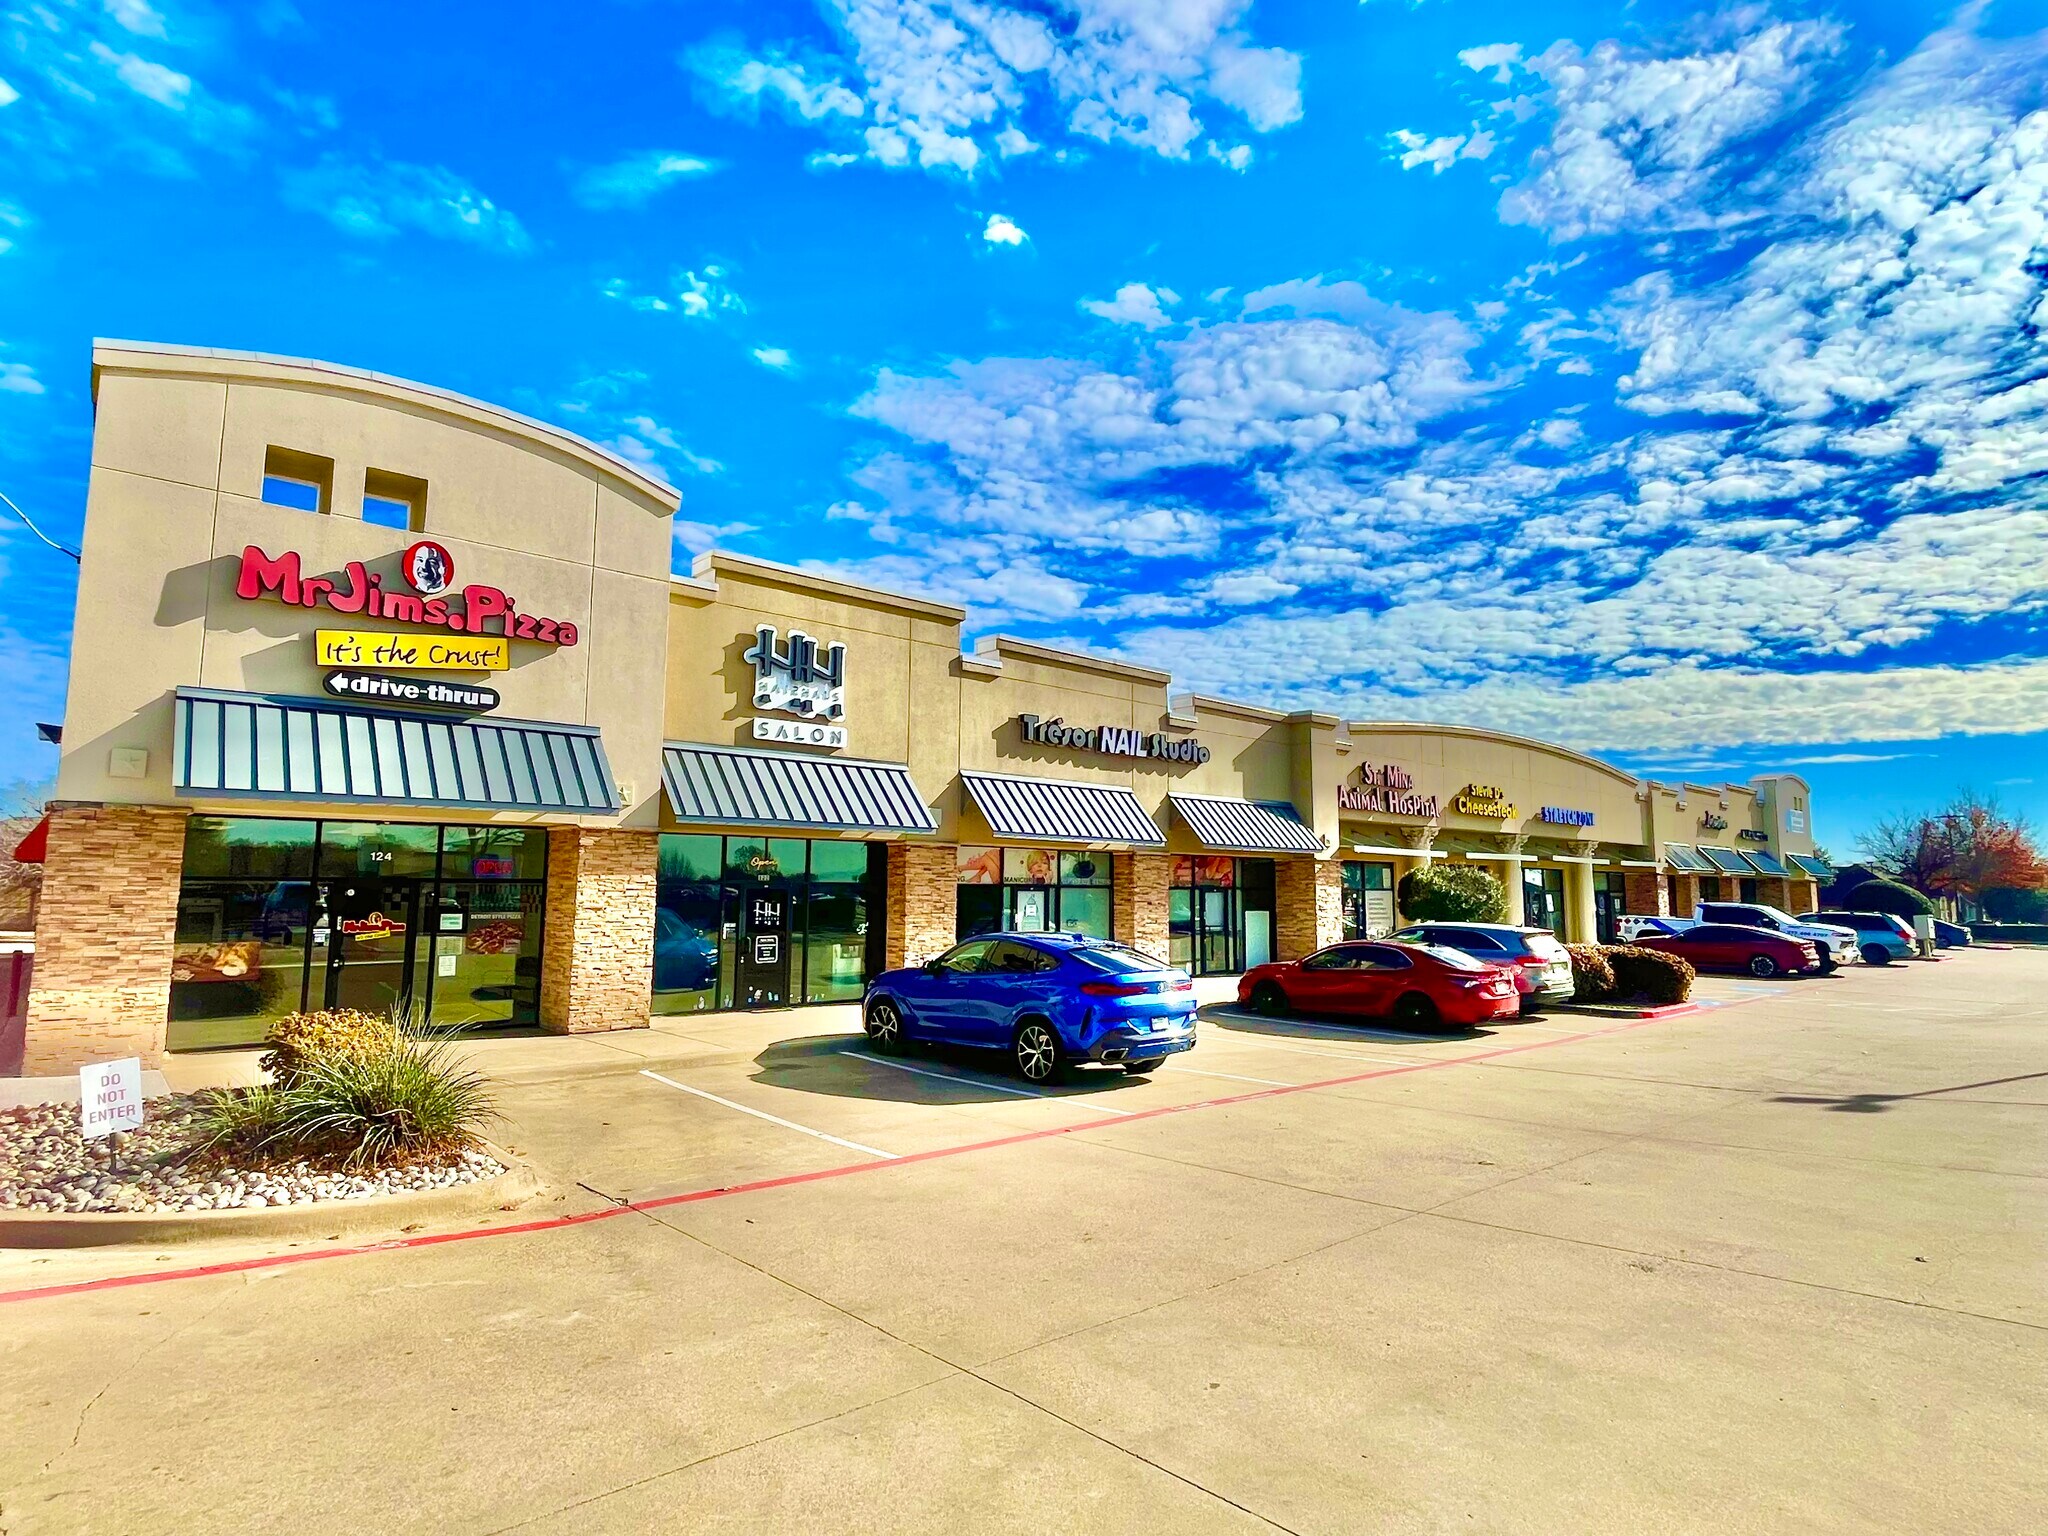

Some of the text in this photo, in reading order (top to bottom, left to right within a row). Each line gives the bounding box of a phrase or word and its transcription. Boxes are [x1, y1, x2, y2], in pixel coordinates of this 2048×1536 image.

[325, 636, 501, 667] It's the Crust!
[350, 677, 481, 706] drive-thru
[757, 722, 842, 745] SALON
[1100, 726, 1148, 757] NAIL
[1151, 733, 1210, 763] Studio
[1457, 796, 1518, 819] Cheesesteak
[370, 851, 393, 861] 124
[750, 857, 779, 870] Open
[101, 1073, 121, 1087] DO
[97, 1088, 127, 1105] NOT
[89, 1104, 136, 1124] ENTER
